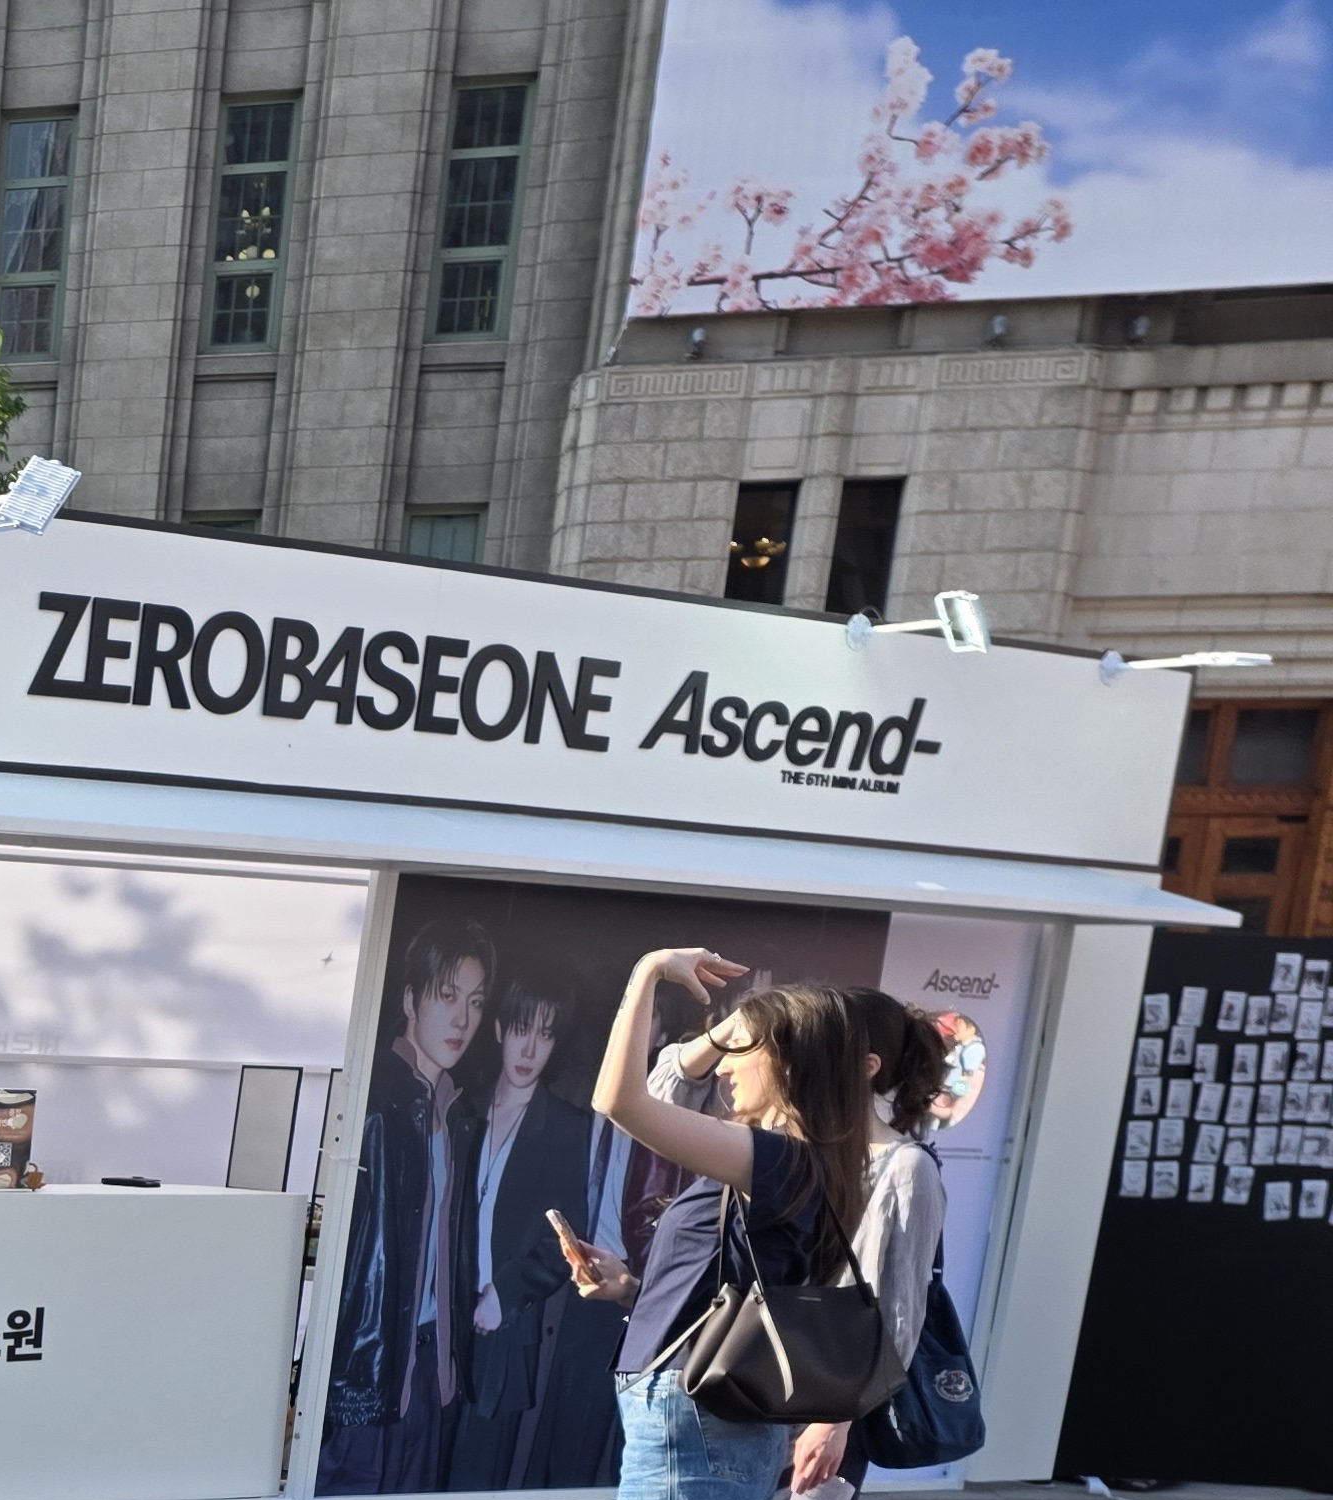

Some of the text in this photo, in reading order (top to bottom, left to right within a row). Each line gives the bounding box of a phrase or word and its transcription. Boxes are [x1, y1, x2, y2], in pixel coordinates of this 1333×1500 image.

[640, 670, 942, 774] Ascend-
[780, 770, 805, 785] THE
[806, 773, 830, 788] 6TH
[922, 968, 1000, 995] Ascend-
